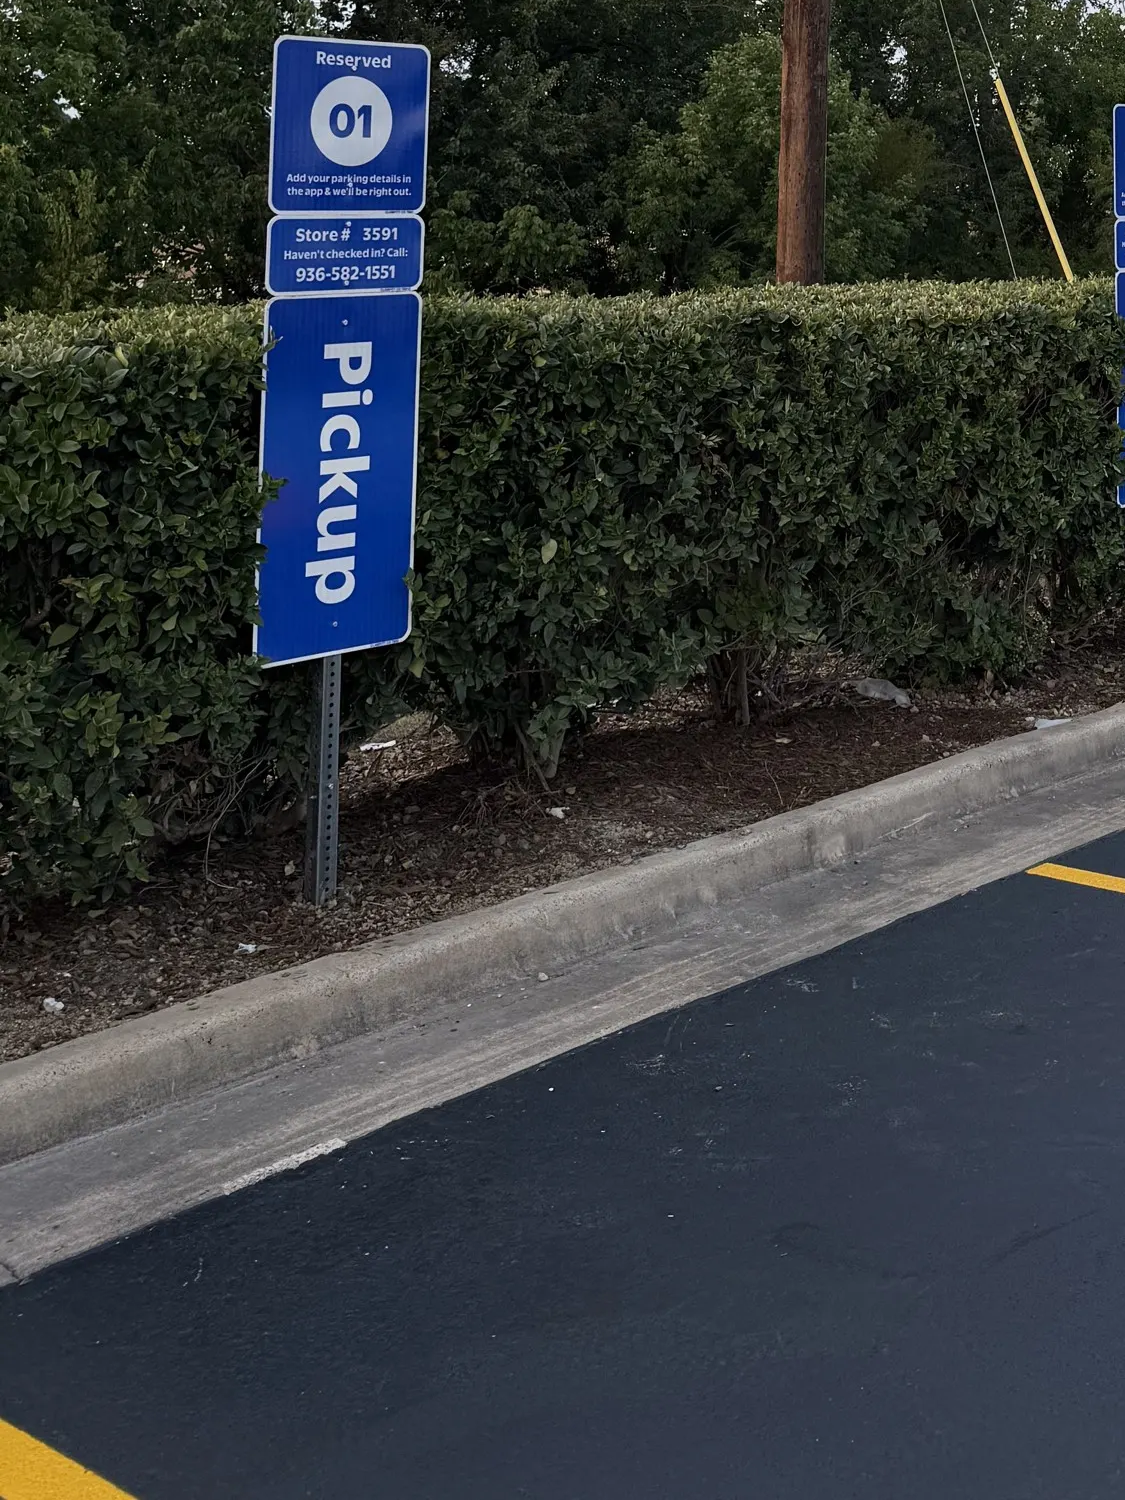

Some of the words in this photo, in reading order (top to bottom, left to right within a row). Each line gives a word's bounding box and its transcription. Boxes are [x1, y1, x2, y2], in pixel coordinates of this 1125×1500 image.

[316, 51, 392, 69] Reserved
[329, 103, 373, 138] 01
[287, 173, 306, 182] Add
[308, 175, 330, 184] your
[331, 174, 369, 184] parking
[370, 174, 401, 183] details
[402, 174, 411, 183] in
[287, 186, 303, 196] the
[305, 188, 323, 197] app
[325, 187, 331, 196] &
[332, 187, 354, 196] we'll
[356, 187, 367, 196] be
[369, 187, 391, 197] right
[393, 188, 411, 196] out.
[295, 228, 338, 242] Store
[341, 228, 350, 241] #
[362, 227, 398, 241] 3591
[284, 250, 324, 260] Haven't
[326, 248, 369, 259] checked
[371, 248, 385, 258] in?
[386, 247, 408, 257] Call:
[295, 265, 396, 282] 936-582-1551
[305, 341, 373, 604] Pickup
